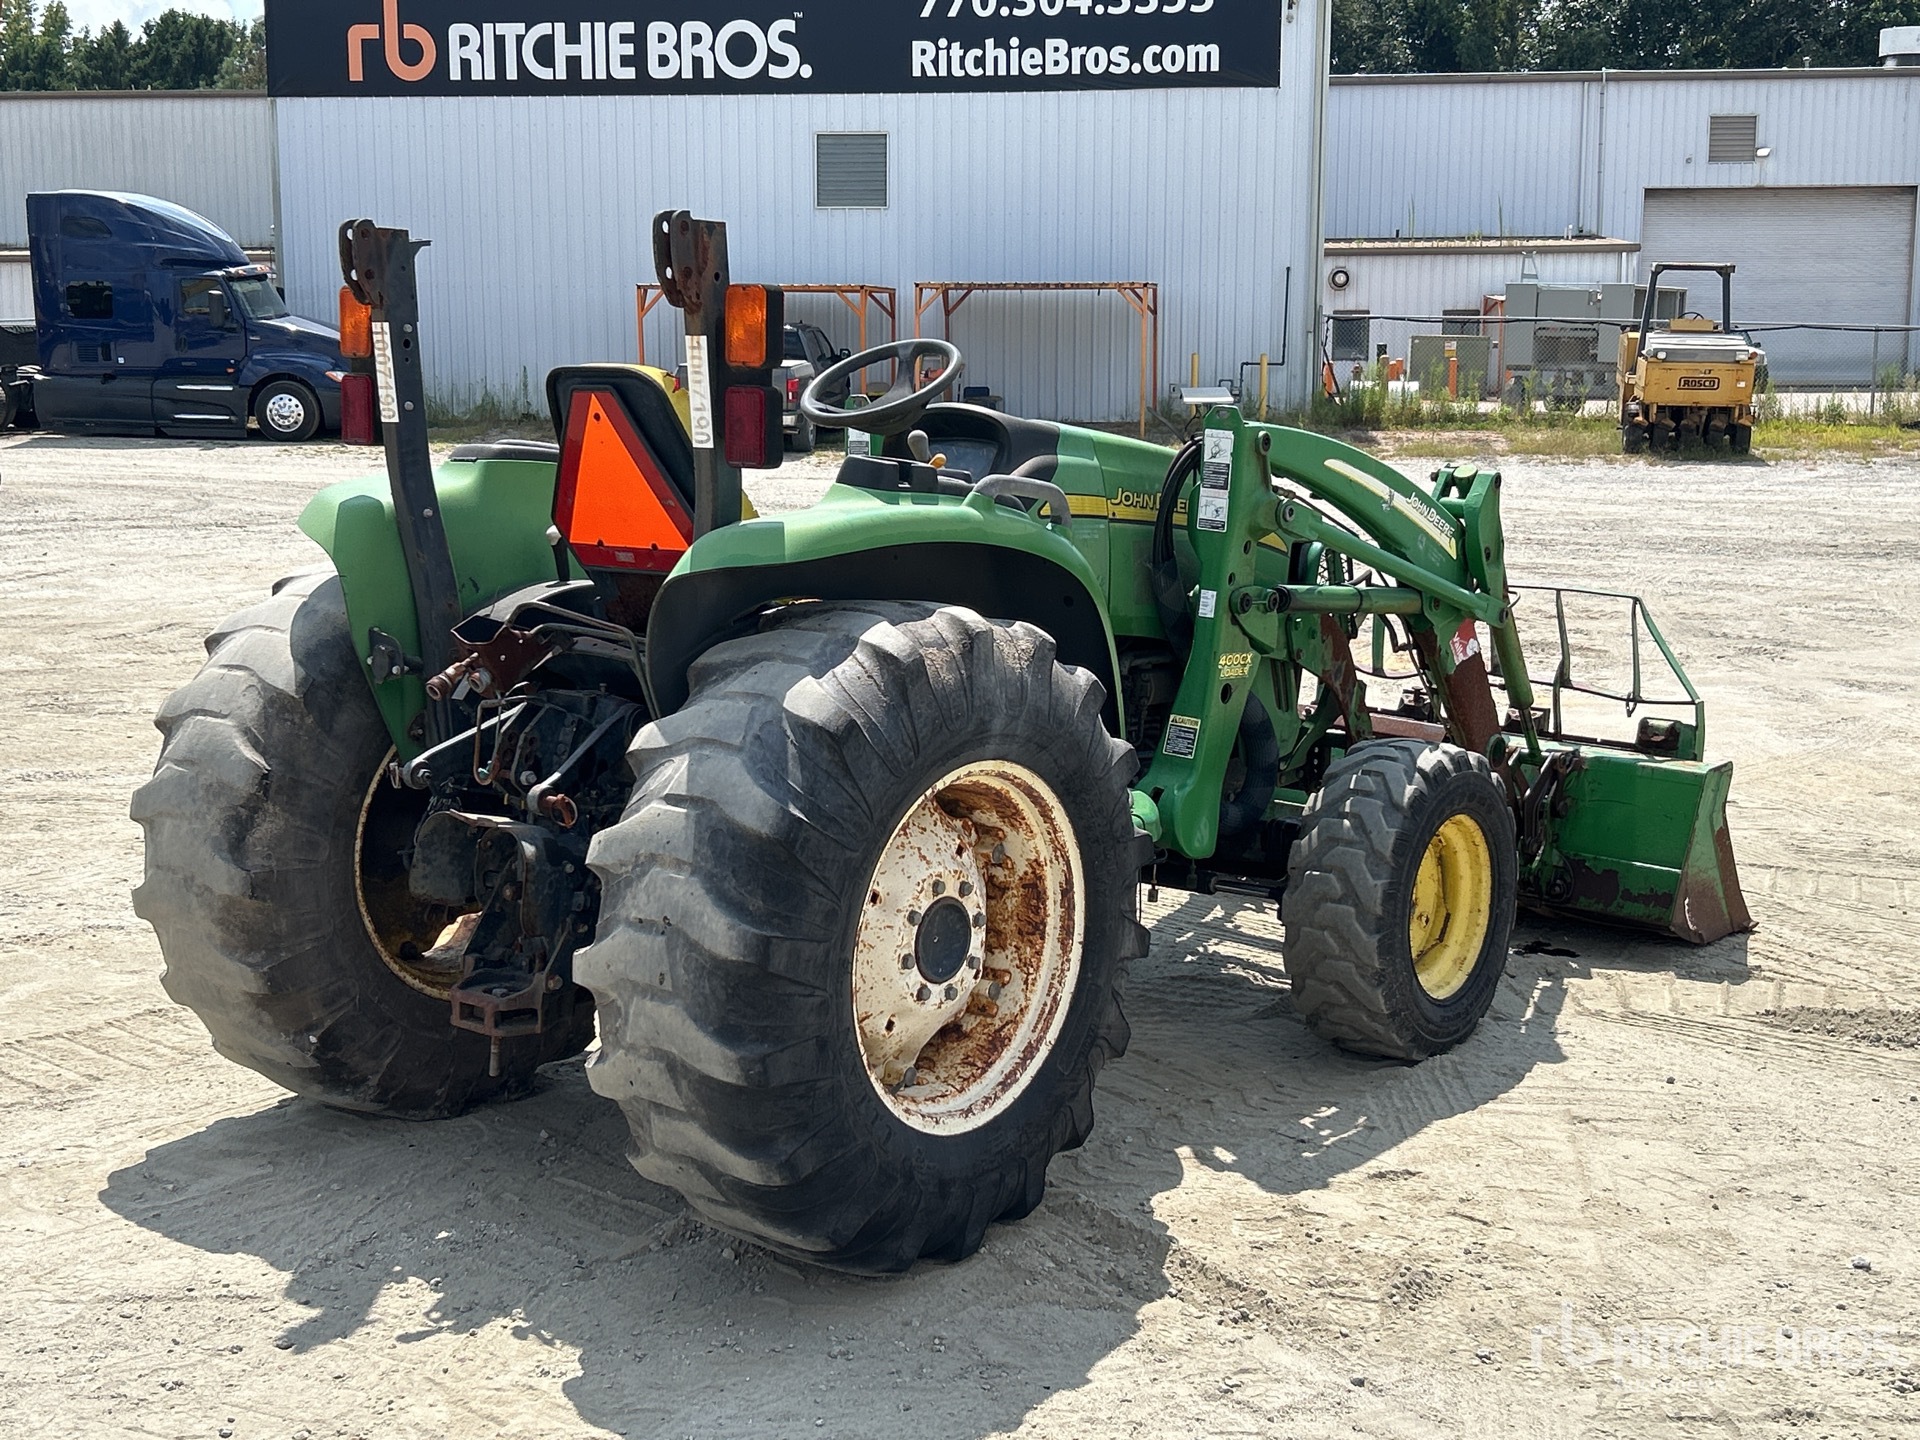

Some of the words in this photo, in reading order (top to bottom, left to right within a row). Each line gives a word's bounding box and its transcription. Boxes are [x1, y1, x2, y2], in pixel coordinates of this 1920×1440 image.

[448, 21, 636, 81] RITCHIE
[647, 18, 813, 80] BROS.
[911, 36, 1220, 77] RitchieBros.com
[1682, 379, 1716, 388] ROSCO
[1111, 487, 1154, 509] JOHN
[1406, 491, 1430, 516] JOHN
[1428, 508, 1456, 539] DEERE
[1218, 653, 1253, 666] 400CX
